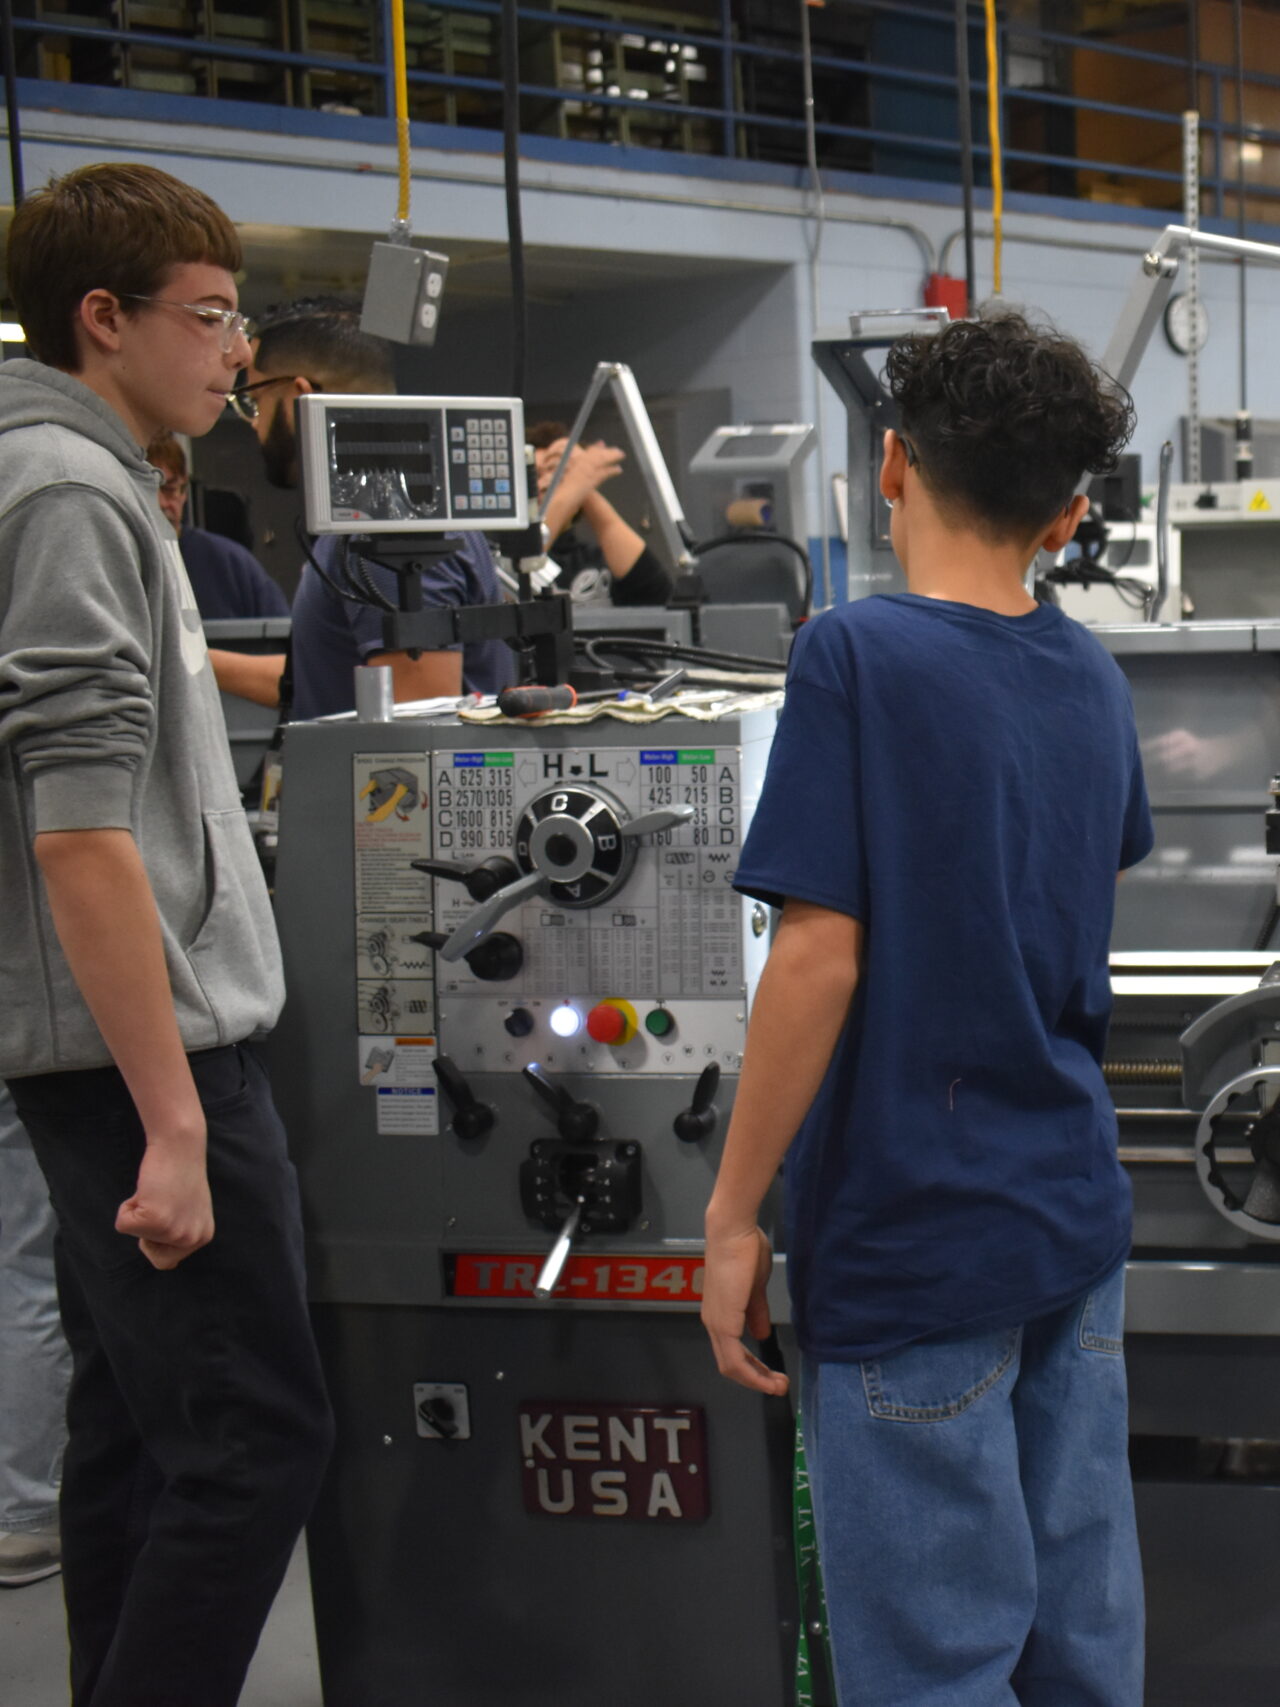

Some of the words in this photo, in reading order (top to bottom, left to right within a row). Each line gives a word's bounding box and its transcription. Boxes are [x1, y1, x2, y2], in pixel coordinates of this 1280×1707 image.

[543, 754, 563, 778] H
[589, 753, 609, 777] L
[437, 770, 453, 786] A
[460, 769, 483, 787] 625
[489, 769, 512, 786] 315
[649, 766, 672, 784] 100
[691, 766, 707, 783] 50
[719, 766, 735, 782] A
[439, 790, 452, 807] B
[456, 790, 483, 807] 2570
[486, 790, 513, 807] 1305
[551, 794, 569, 812] C
[649, 787, 672, 805] 425
[684, 787, 708, 804] 215
[720, 787, 734, 804] B
[438, 810, 453, 827] C
[456, 810, 483, 827] 1600
[490, 810, 513, 827] 815
[719, 807, 735, 825] C
[440, 831, 453, 848] D
[460, 830, 483, 848] 990
[490, 830, 513, 848] 505
[597, 834, 617, 852] B
[694, 828, 709, 846] 80
[720, 828, 735, 844] D
[452, 851, 458, 860] L
[565, 883, 582, 898] A
[520, 1413, 691, 1464] KENT
[796, 1466, 810, 1491] VT
[537, 1468, 683, 1518] USA
[798, 1506, 812, 1530] VT
